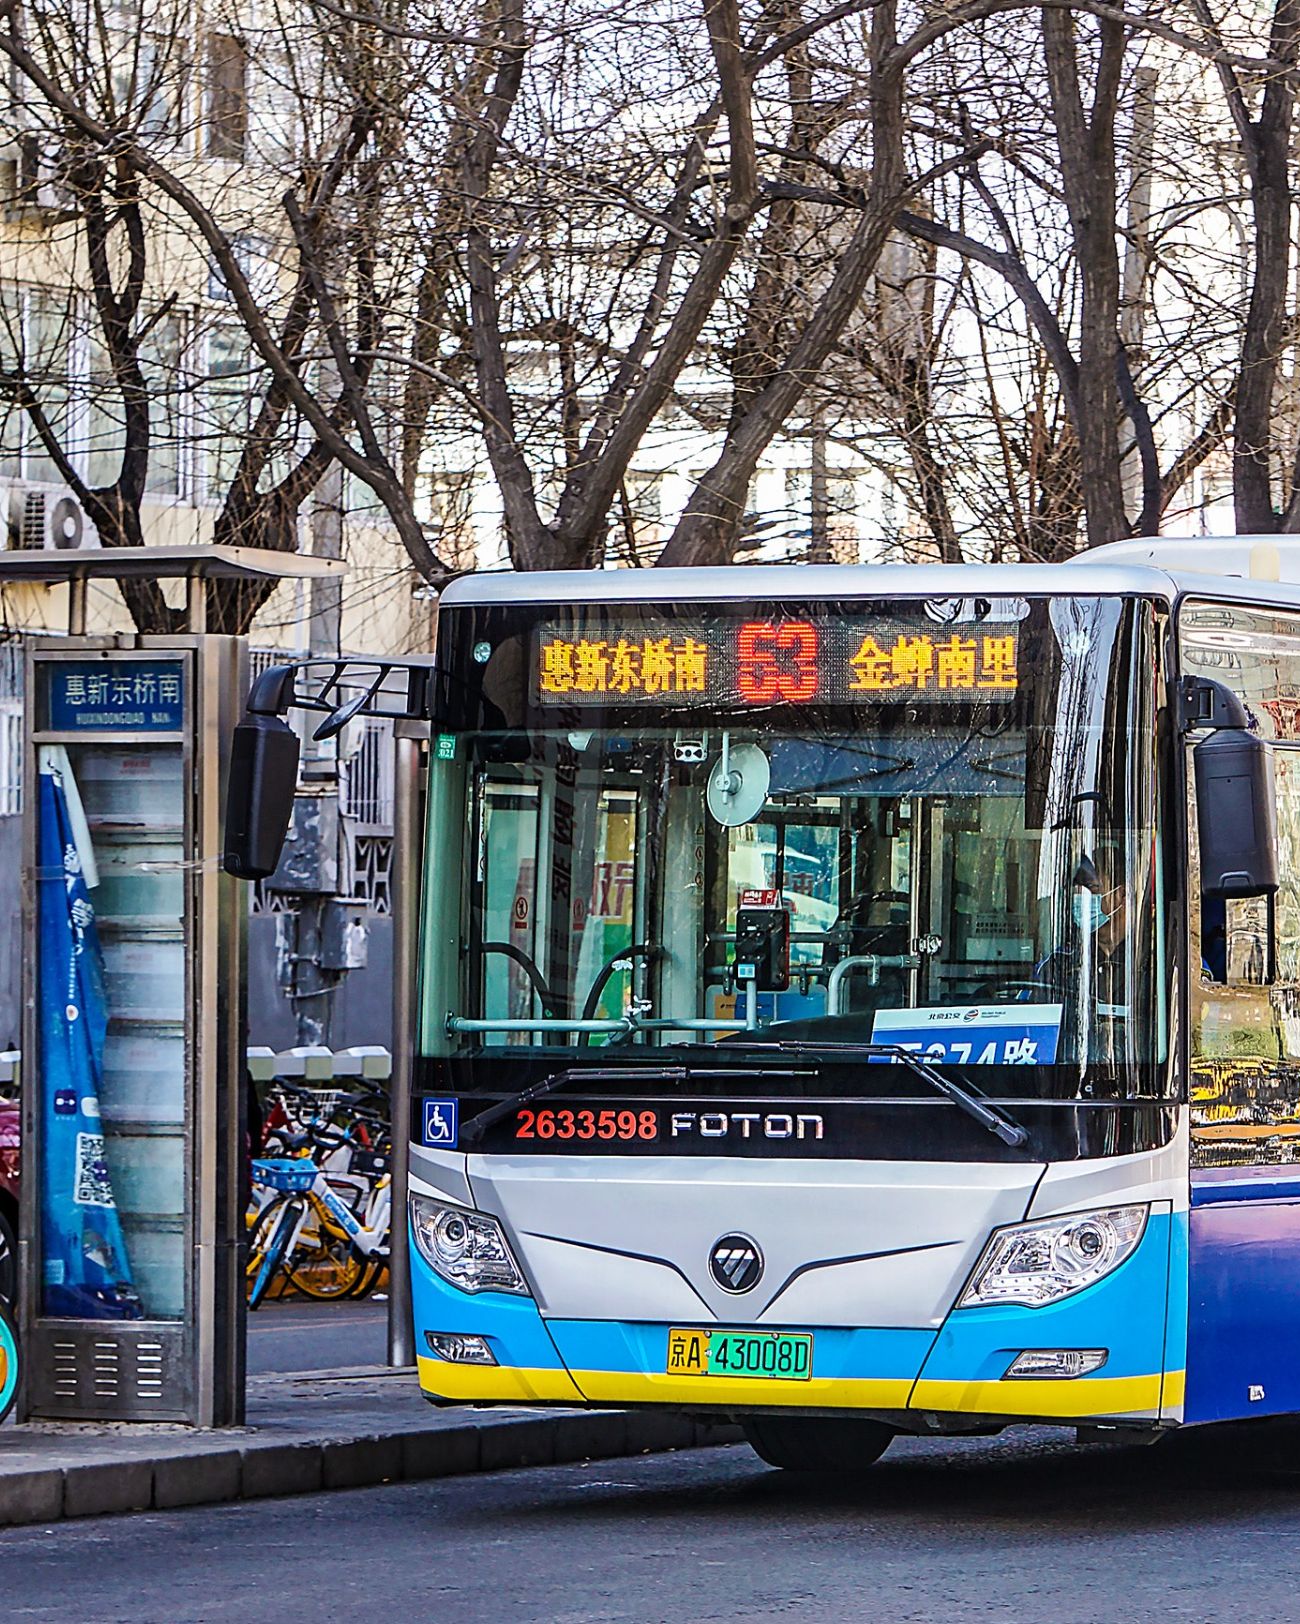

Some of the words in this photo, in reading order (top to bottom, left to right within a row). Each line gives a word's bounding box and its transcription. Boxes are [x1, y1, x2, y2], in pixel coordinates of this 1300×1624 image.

[540, 639, 707, 693] 惠新东桥南
[738, 623, 817, 701] 63
[849, 635, 1018, 689] 金蝉南里
[65, 673, 180, 705] 惠新东桥南
[516, 1110, 657, 1140] 2633598
[671, 1112, 824, 1139] FOTON
